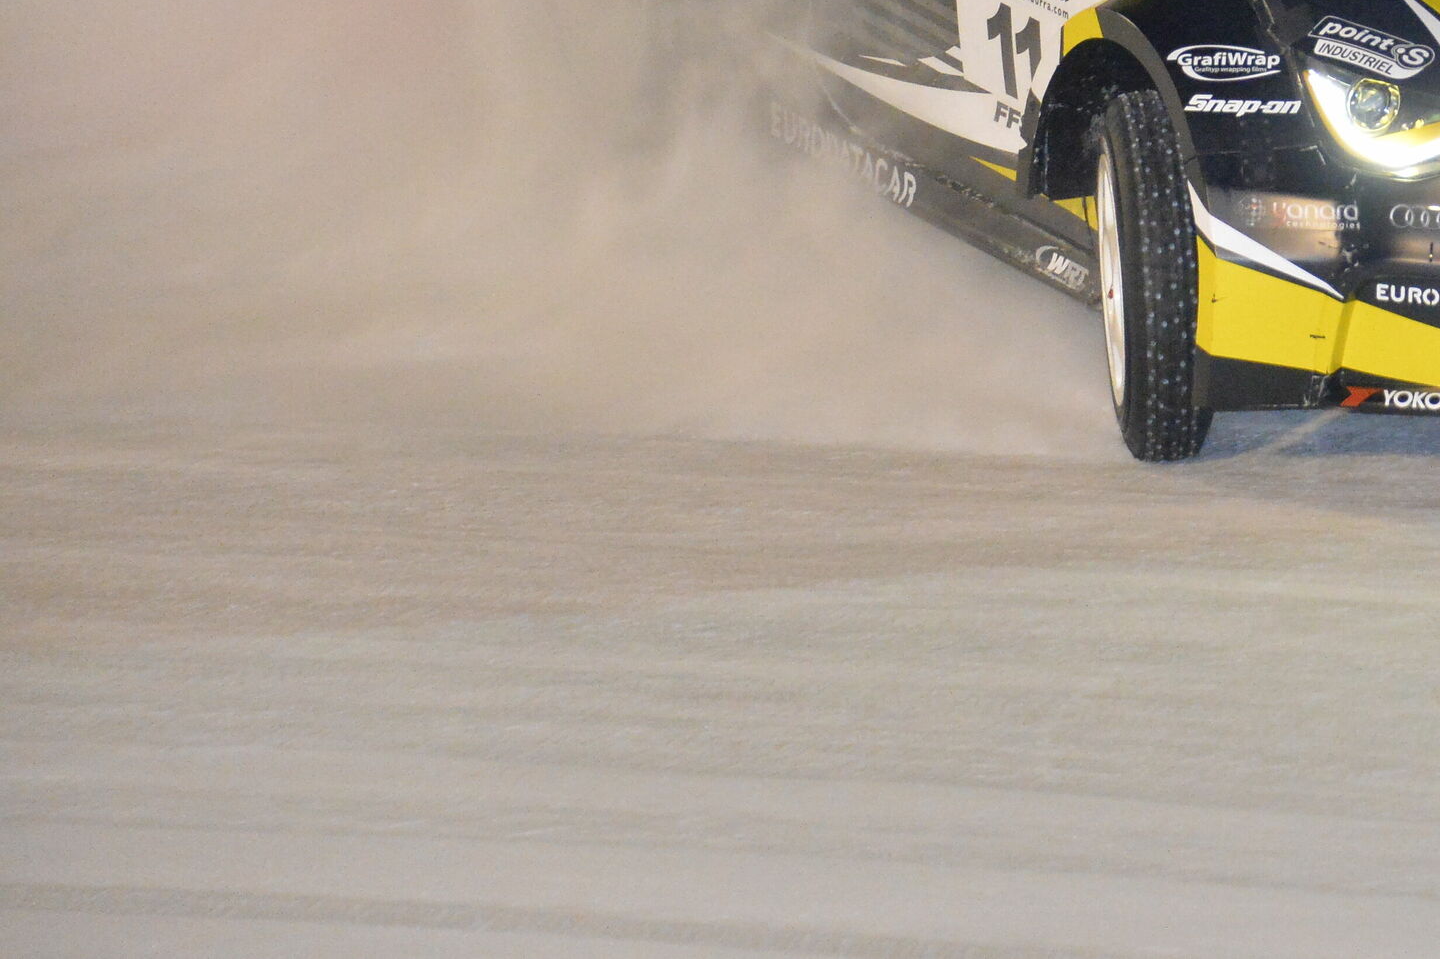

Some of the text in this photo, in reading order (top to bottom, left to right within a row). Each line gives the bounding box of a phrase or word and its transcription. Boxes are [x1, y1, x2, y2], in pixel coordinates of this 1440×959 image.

[986, 2, 1042, 100] 11
[1319, 21, 1395, 52] point
[1177, 52, 1281, 69] GrafiWrap
[1318, 42, 1393, 76] INDUSTRIEL
[1183, 93, 1301, 118] Snap-on
